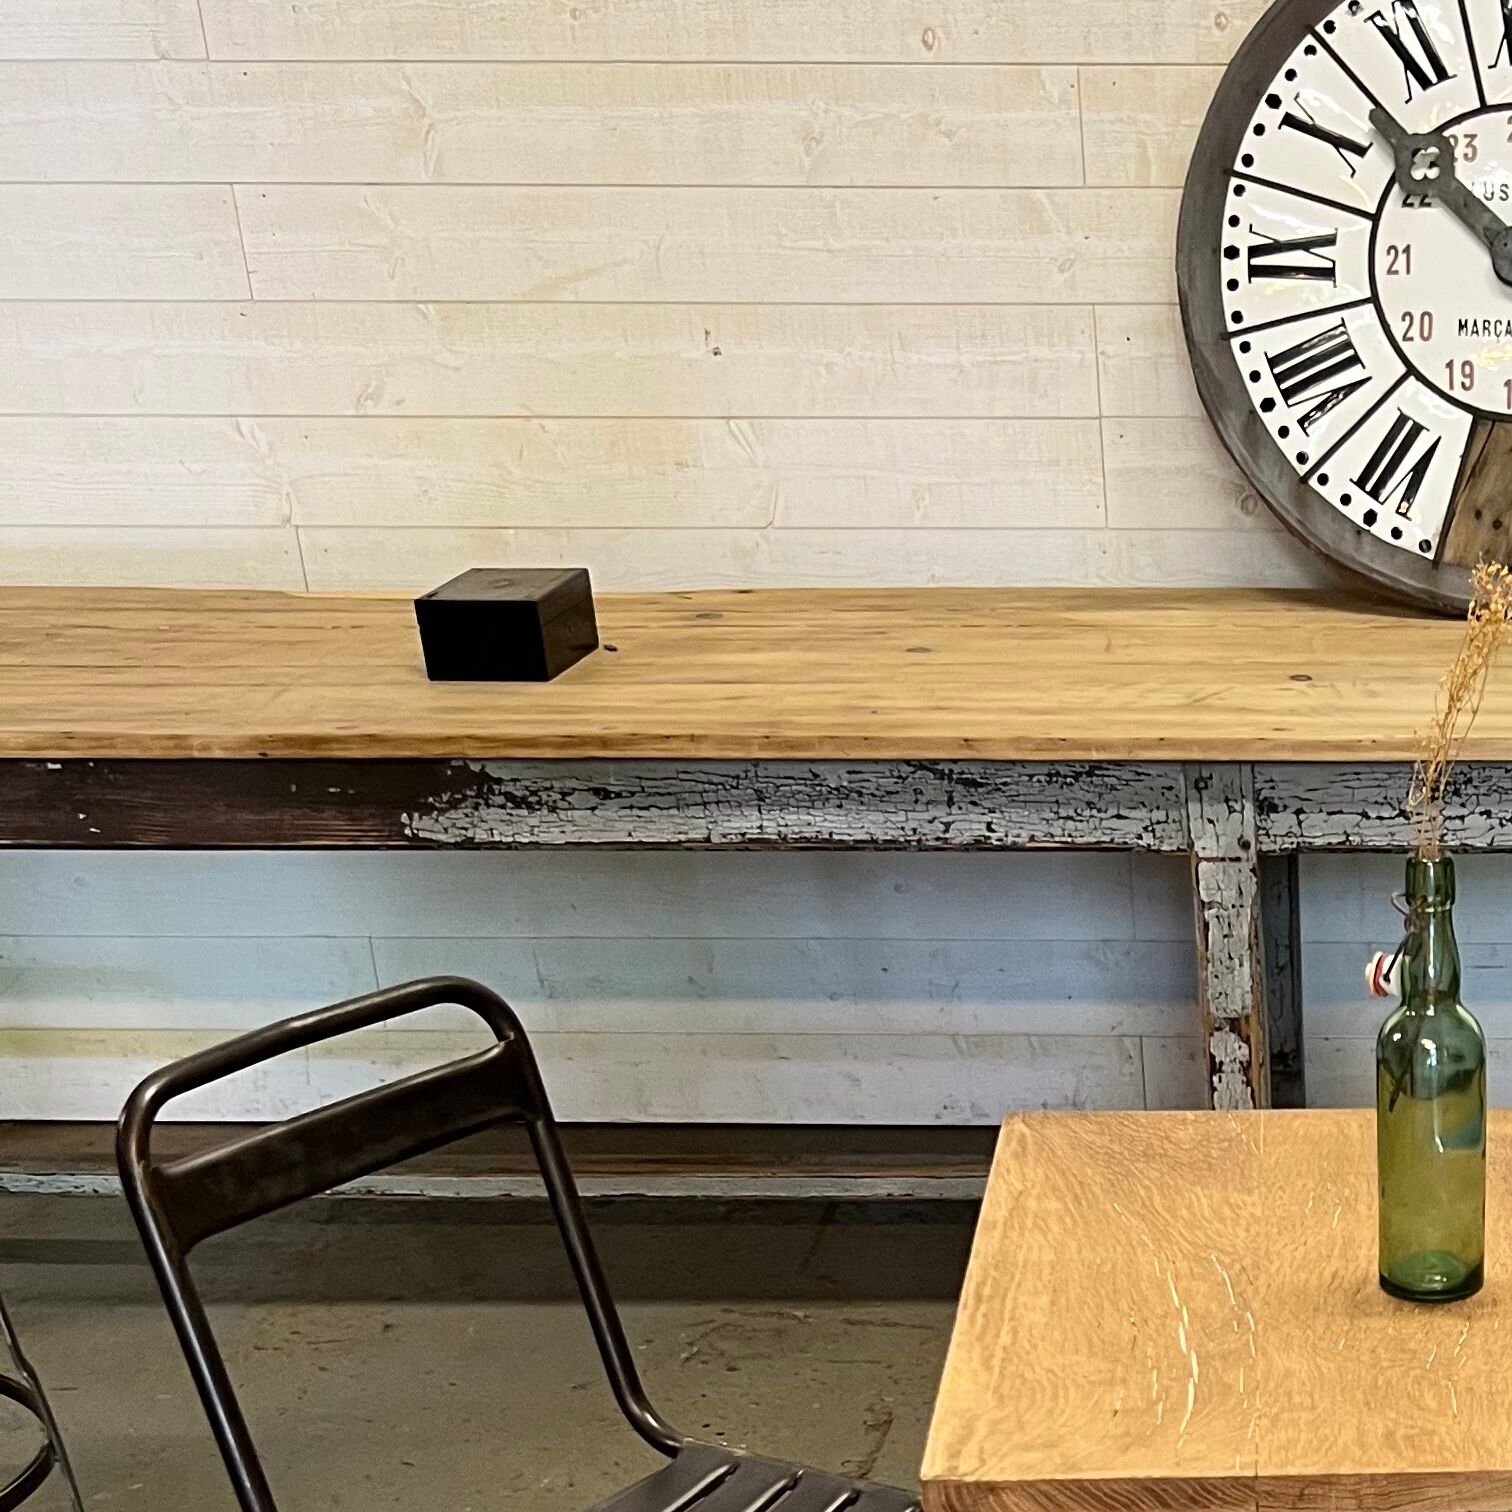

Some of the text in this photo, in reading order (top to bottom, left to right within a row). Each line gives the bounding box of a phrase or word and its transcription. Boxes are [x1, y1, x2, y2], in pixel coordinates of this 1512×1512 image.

[1386, 244, 1411, 276] 21
[1401, 311, 1433, 342] 20
[1445, 359, 1475, 391] 19
